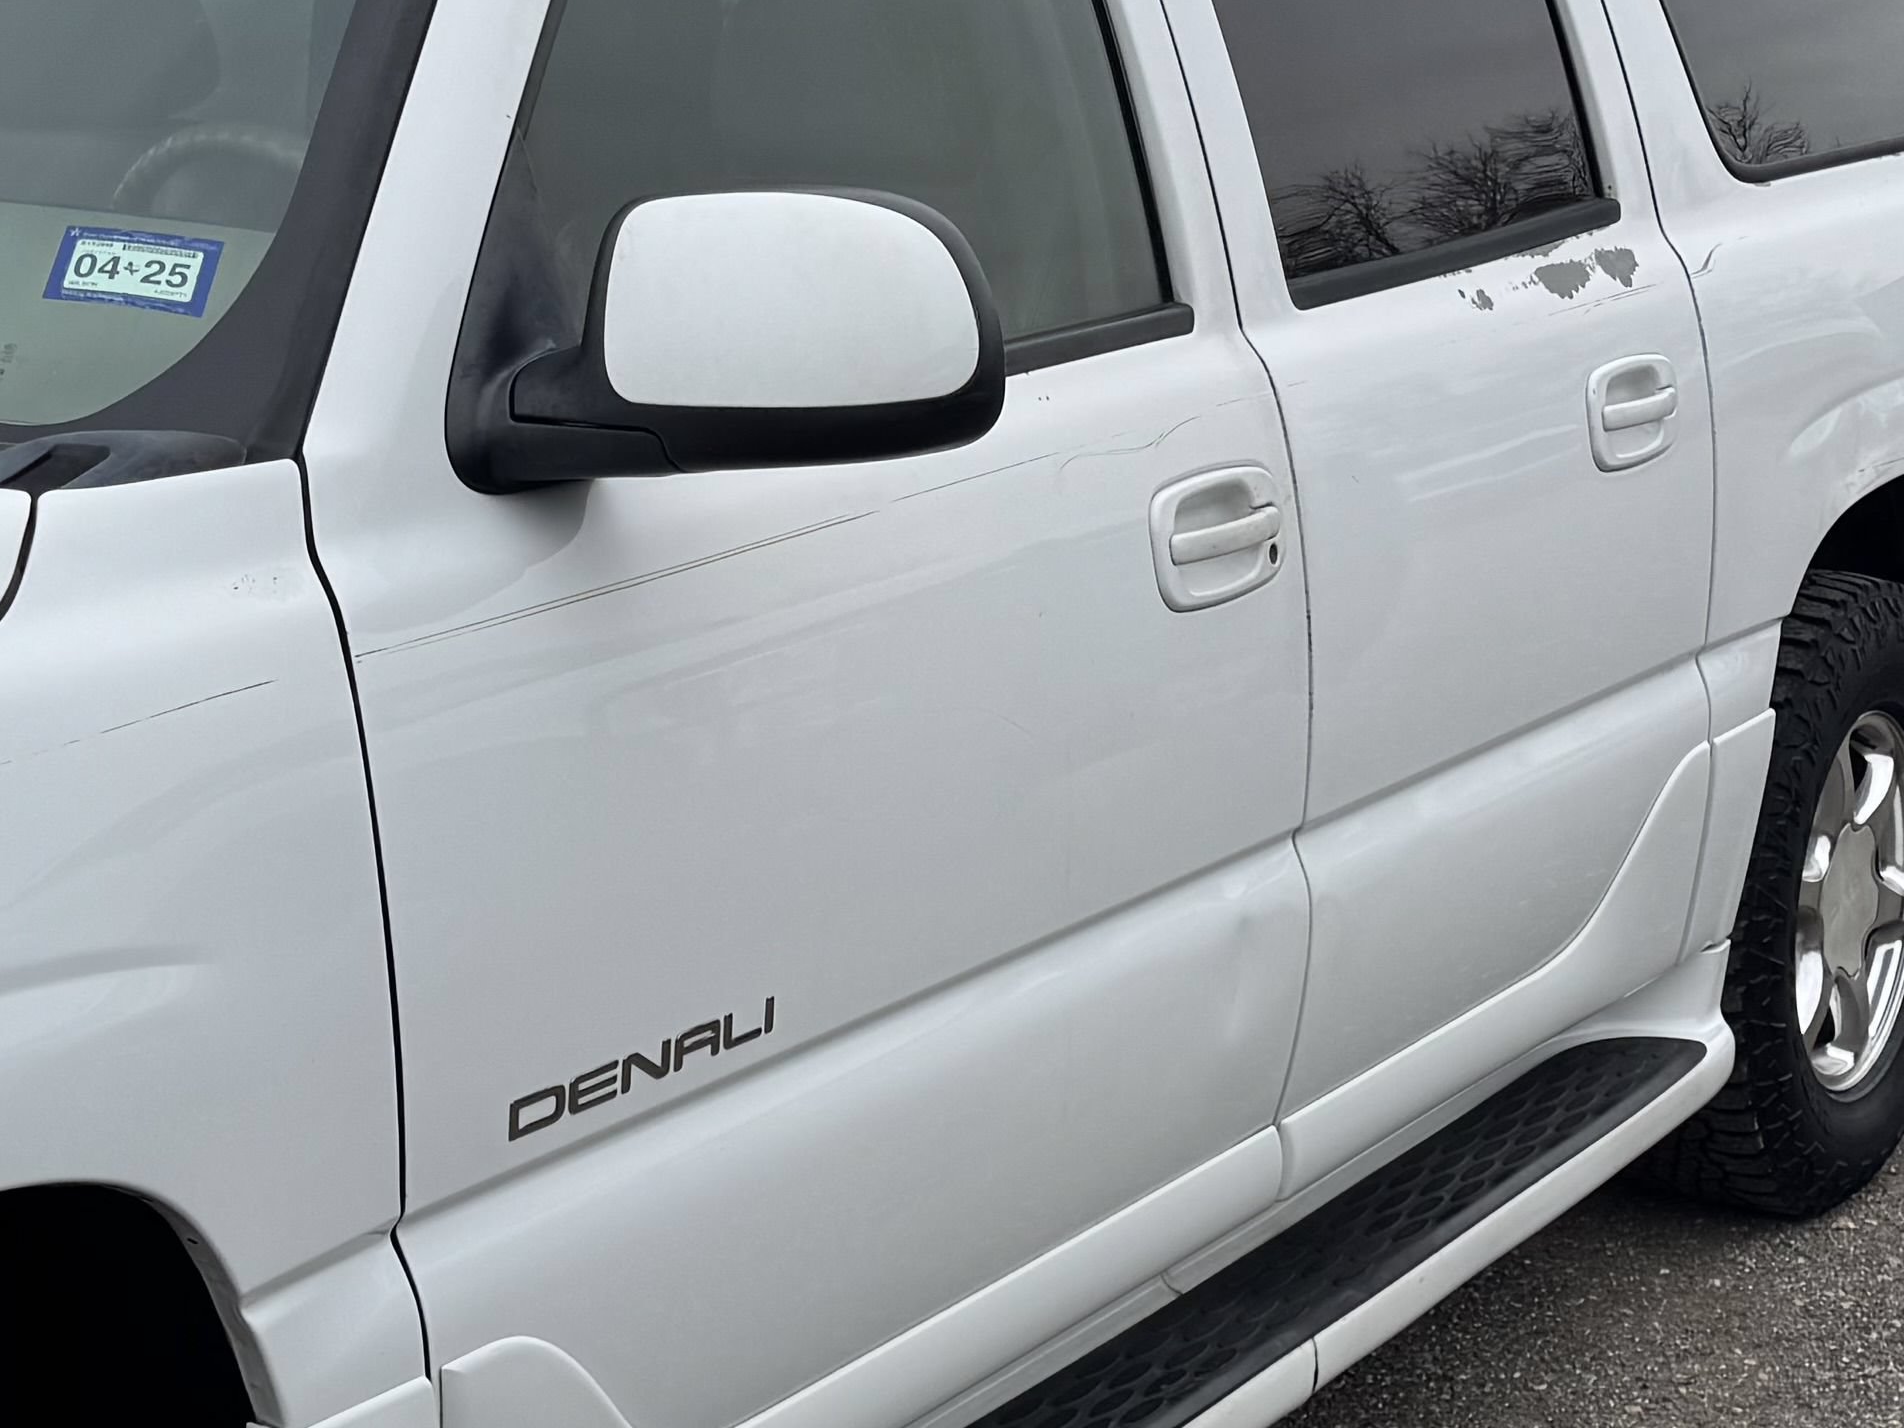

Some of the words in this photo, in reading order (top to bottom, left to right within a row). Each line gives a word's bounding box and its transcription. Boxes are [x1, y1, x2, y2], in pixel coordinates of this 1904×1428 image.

[73, 253, 121, 280] 04
[140, 260, 191, 288] 25
[507, 995, 775, 1142] DENALI
